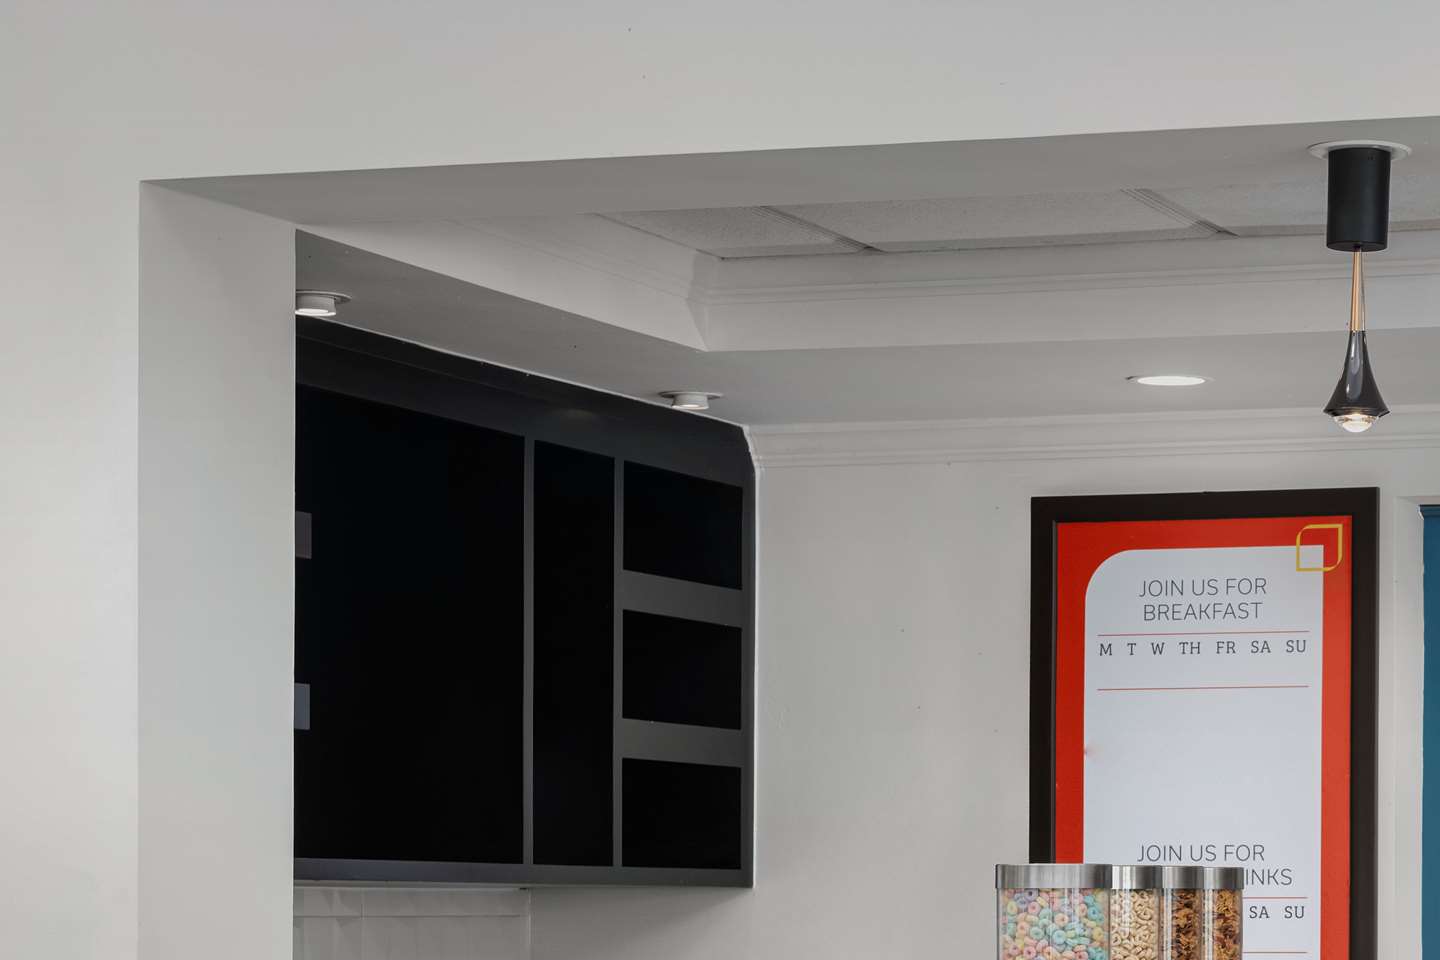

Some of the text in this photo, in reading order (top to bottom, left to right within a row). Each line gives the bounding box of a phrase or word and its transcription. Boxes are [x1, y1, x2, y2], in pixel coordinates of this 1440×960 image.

[1138, 577, 1267, 598] JOIN US FOR
[1143, 601, 1263, 622] BREAKFAST
[1099, 639, 1307, 657] M T W TH FR SA SU
[1136, 843, 1265, 863] JOIN US FOR
[1245, 868, 1293, 886] INKS
[1249, 905, 1305, 919] SA SU
